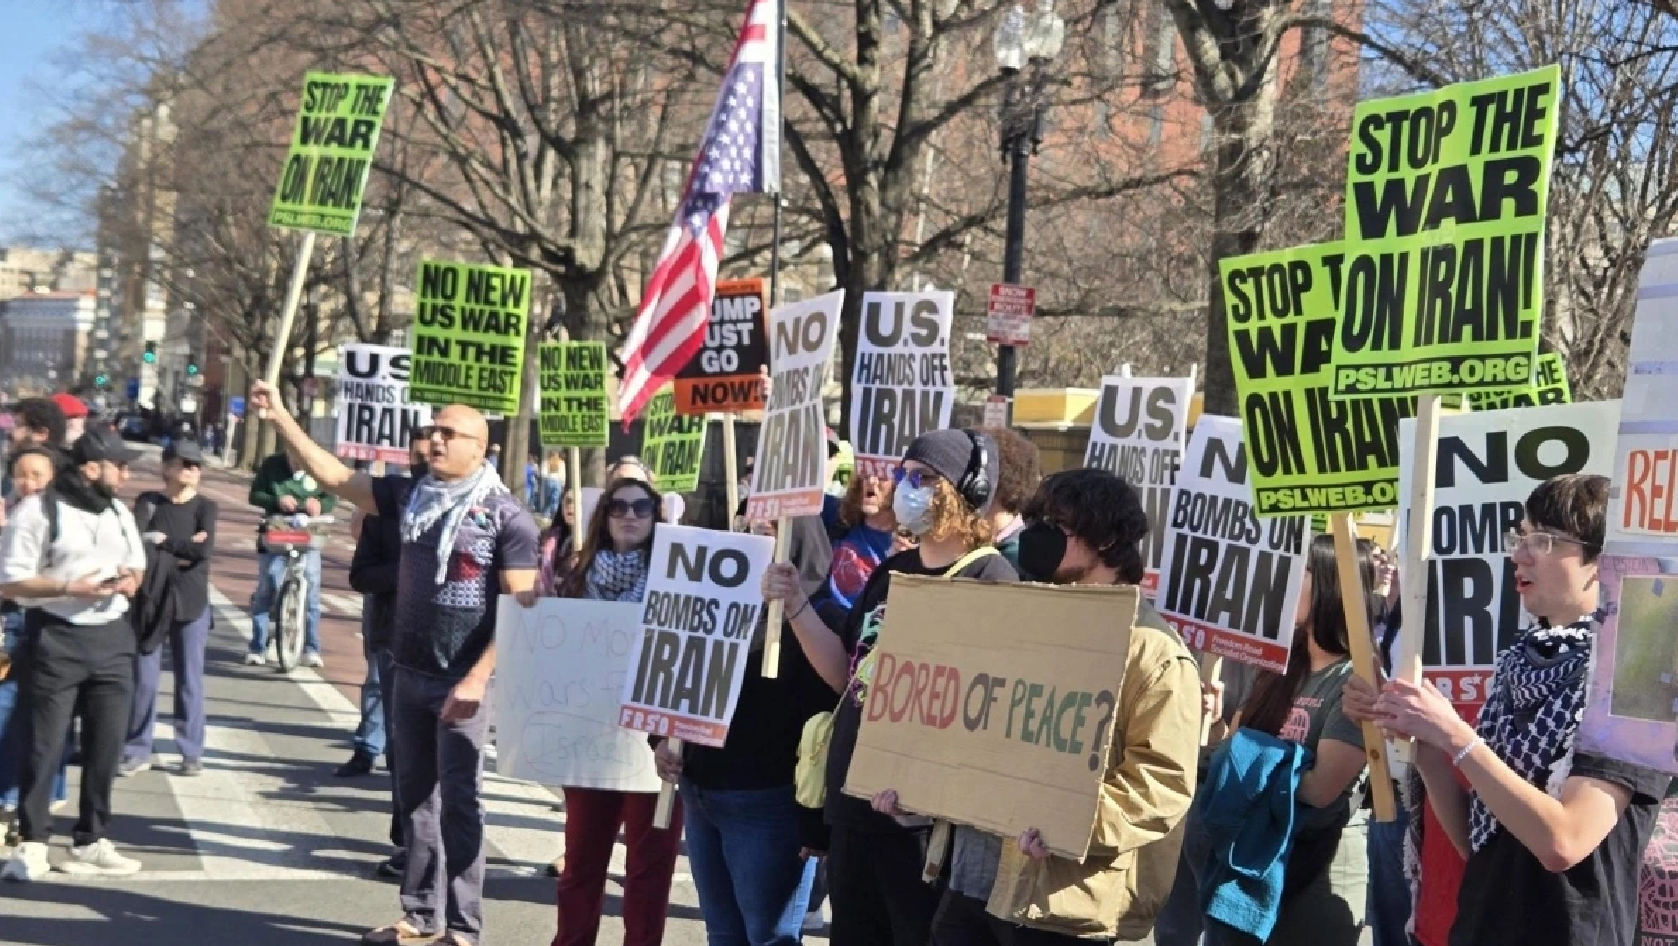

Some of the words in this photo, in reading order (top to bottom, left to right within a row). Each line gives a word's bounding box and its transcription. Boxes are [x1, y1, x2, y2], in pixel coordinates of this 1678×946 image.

[304, 81, 349, 113] STOP
[351, 85, 387, 117] THE
[300, 116, 376, 150] WAR
[1355, 100, 1457, 176] STOP
[1469, 82, 1552, 157] THE
[280, 154, 310, 205] ON
[308, 156, 366, 210] IRAN!
[1353, 156, 1541, 240] WAR
[421, 264, 459, 300] NO
[465, 268, 527, 309] NEW
[711, 296, 761, 322] UMP
[1228, 260, 1313, 324] STOP
[1341, 251, 1409, 354] ON
[1414, 232, 1538, 348] IRAN!
[419, 302, 456, 330] US
[460, 306, 521, 337] WAR
[705, 323, 754, 347] UST
[777, 311, 827, 361] NO
[865, 299, 945, 347] U.S.
[346, 350, 411, 381] U.S
[416, 335, 450, 359] IN
[455, 339, 518, 367] THE
[541, 346, 561, 371] NO
[565, 346, 603, 371] NEW
[701, 348, 739, 373] GO
[857, 353, 915, 385] HANDS
[919, 353, 947, 386] OFF
[1233, 316, 1337, 379] WA
[344, 381, 395, 403] HANDS
[412, 358, 473, 390] MIDDLE
[478, 365, 517, 395] EAST
[541, 373, 562, 391] US
[564, 373, 604, 391] WAR
[1338, 357, 1529, 391] PSLWEB.ORG
[1537, 359, 1562, 387] HE
[345, 402, 419, 448] IRAN
[541, 397, 561, 412] IN
[564, 396, 606, 412] THE
[541, 414, 579, 433] MIDDLE
[581, 414, 605, 433] EAST
[857, 387, 944, 456] IRAN
[1100, 384, 1178, 441] U.S.
[755, 403, 820, 492] IRAN
[1246, 388, 1307, 477] ON
[1305, 387, 1418, 474] IRAN
[1087, 441, 1146, 484] HANDS
[1151, 447, 1181, 485] OFF
[1200, 437, 1247, 485] N
[1435, 426, 1589, 488] NO
[1171, 488, 1261, 546] BOMBS
[1259, 481, 1397, 509] PSLWEB.O
[1407, 501, 1524, 556] OMB
[667, 542, 750, 588] NO
[1164, 532, 1292, 640] IRAN
[643, 590, 720, 636] BOMBS
[723, 601, 757, 640] ON
[631, 629, 739, 719] IRAN
[867, 653, 961, 729] BORED
[963, 672, 1006, 732] OF
[1005, 678, 1116, 771] PEACE?
